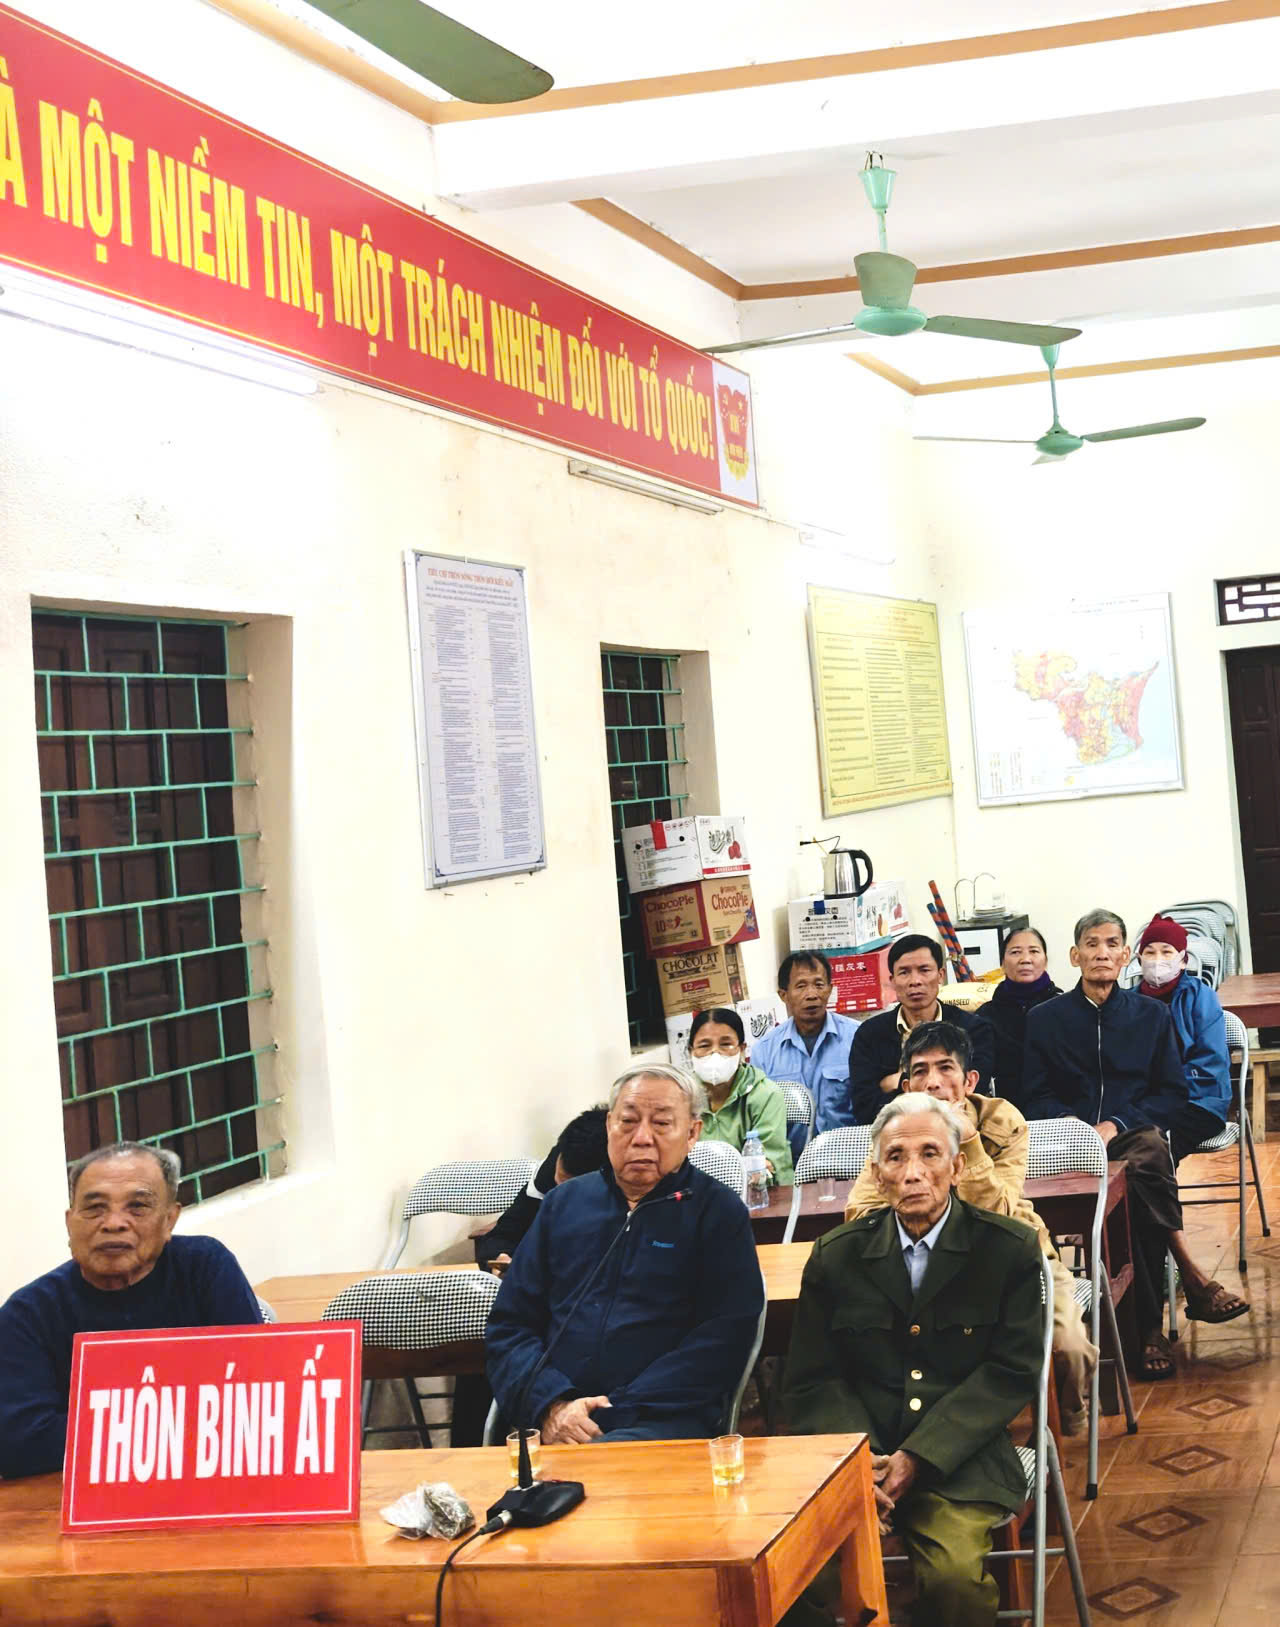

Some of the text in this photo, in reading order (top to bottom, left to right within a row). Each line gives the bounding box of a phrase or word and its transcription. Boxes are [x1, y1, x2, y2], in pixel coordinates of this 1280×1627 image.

[39, 97, 134, 264] MỘT
[147, 135, 250, 290] NIỀM
[256, 195, 324, 329] TIN,
[330, 223, 394, 357] MỘT
[400, 258, 487, 376] TRÁCH
[490, 299, 565, 416] NHIỆM
[568, 316, 604, 420] ĐỐI
[605, 342, 638, 432] VỚI
[638, 345, 663, 441] TỔ
[665, 365, 715, 460] QUỐC!
[646, 894, 695, 913] ChocoPie
[711, 891, 749, 910] ChocoPie
[662, 951, 719, 973] CHOCOLAT
[89, 1344, 342, 1485] THÔN BÍNH ẤT
